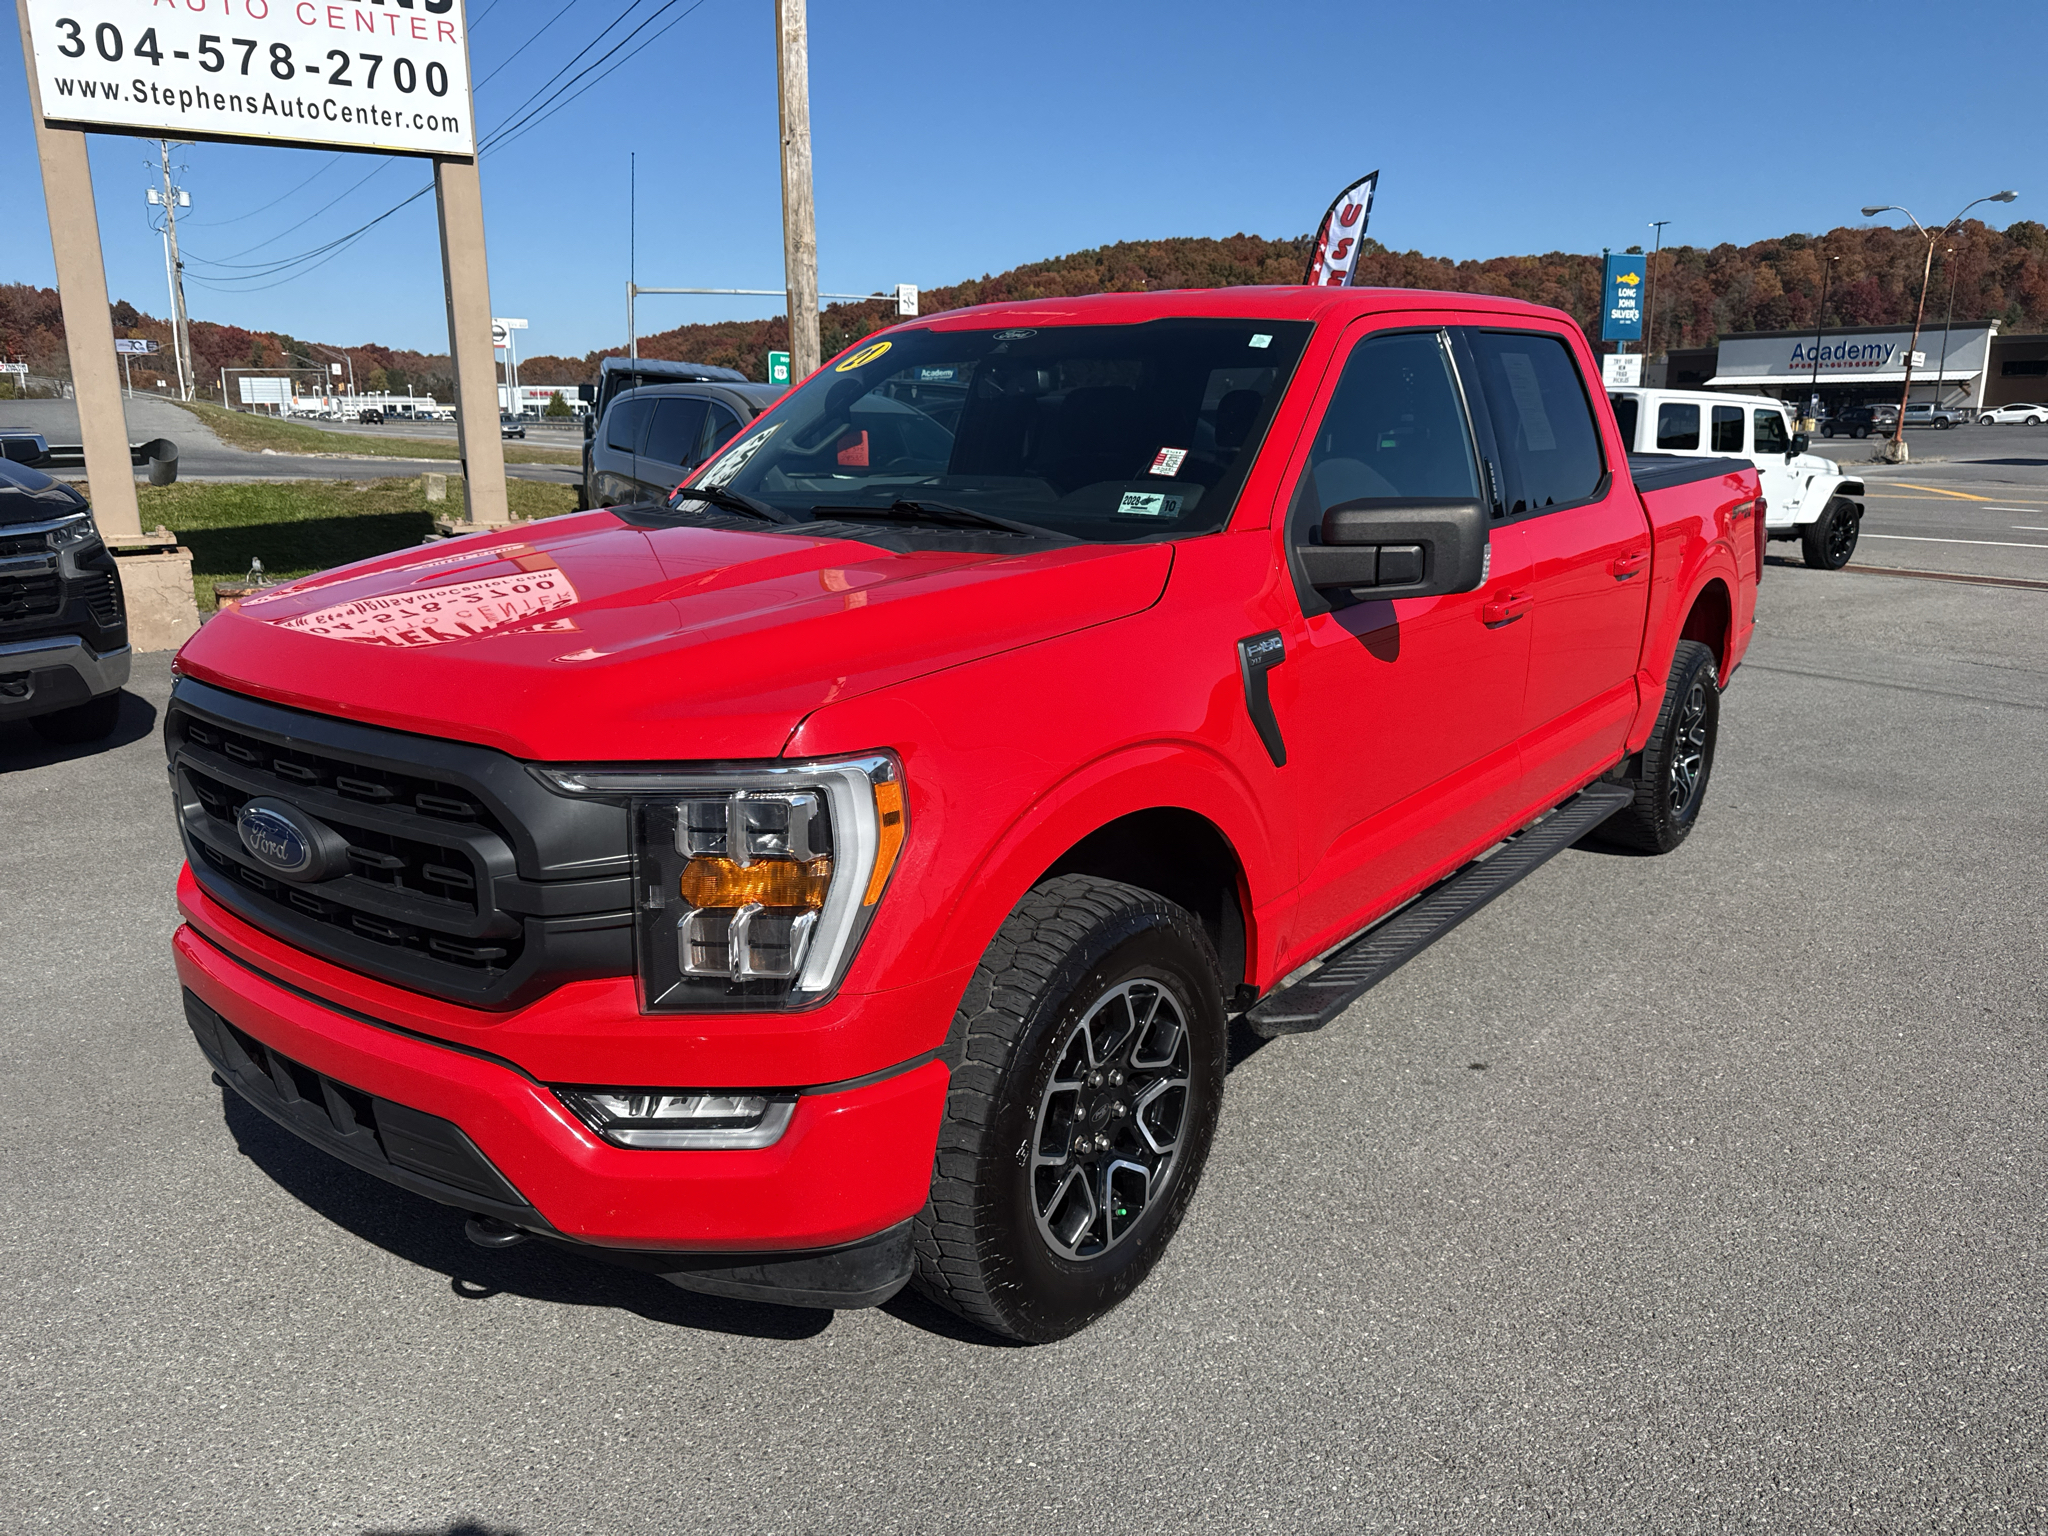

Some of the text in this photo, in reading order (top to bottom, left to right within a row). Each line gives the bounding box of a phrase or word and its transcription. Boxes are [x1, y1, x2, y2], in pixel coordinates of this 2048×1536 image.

[296, 2, 458, 44] CENTER
[54, 17, 450, 97] 304-578-2700
[54, 76, 460, 134] www.StephensAutoCenter.com
[1618, 288, 1636, 298] LONG
[1618, 299, 1636, 308] JOHN
[1611, 308, 1640, 322] SILVER'S
[1790, 340, 1897, 364] Academy
[777, 369, 785, 377] 19
[921, 369, 954, 378] Academy
[1122, 495, 1141, 506] 2028
[1164, 500, 1176, 512] 10
[1247, 637, 1283, 656] F-150
[249, 820, 289, 860] Ford
